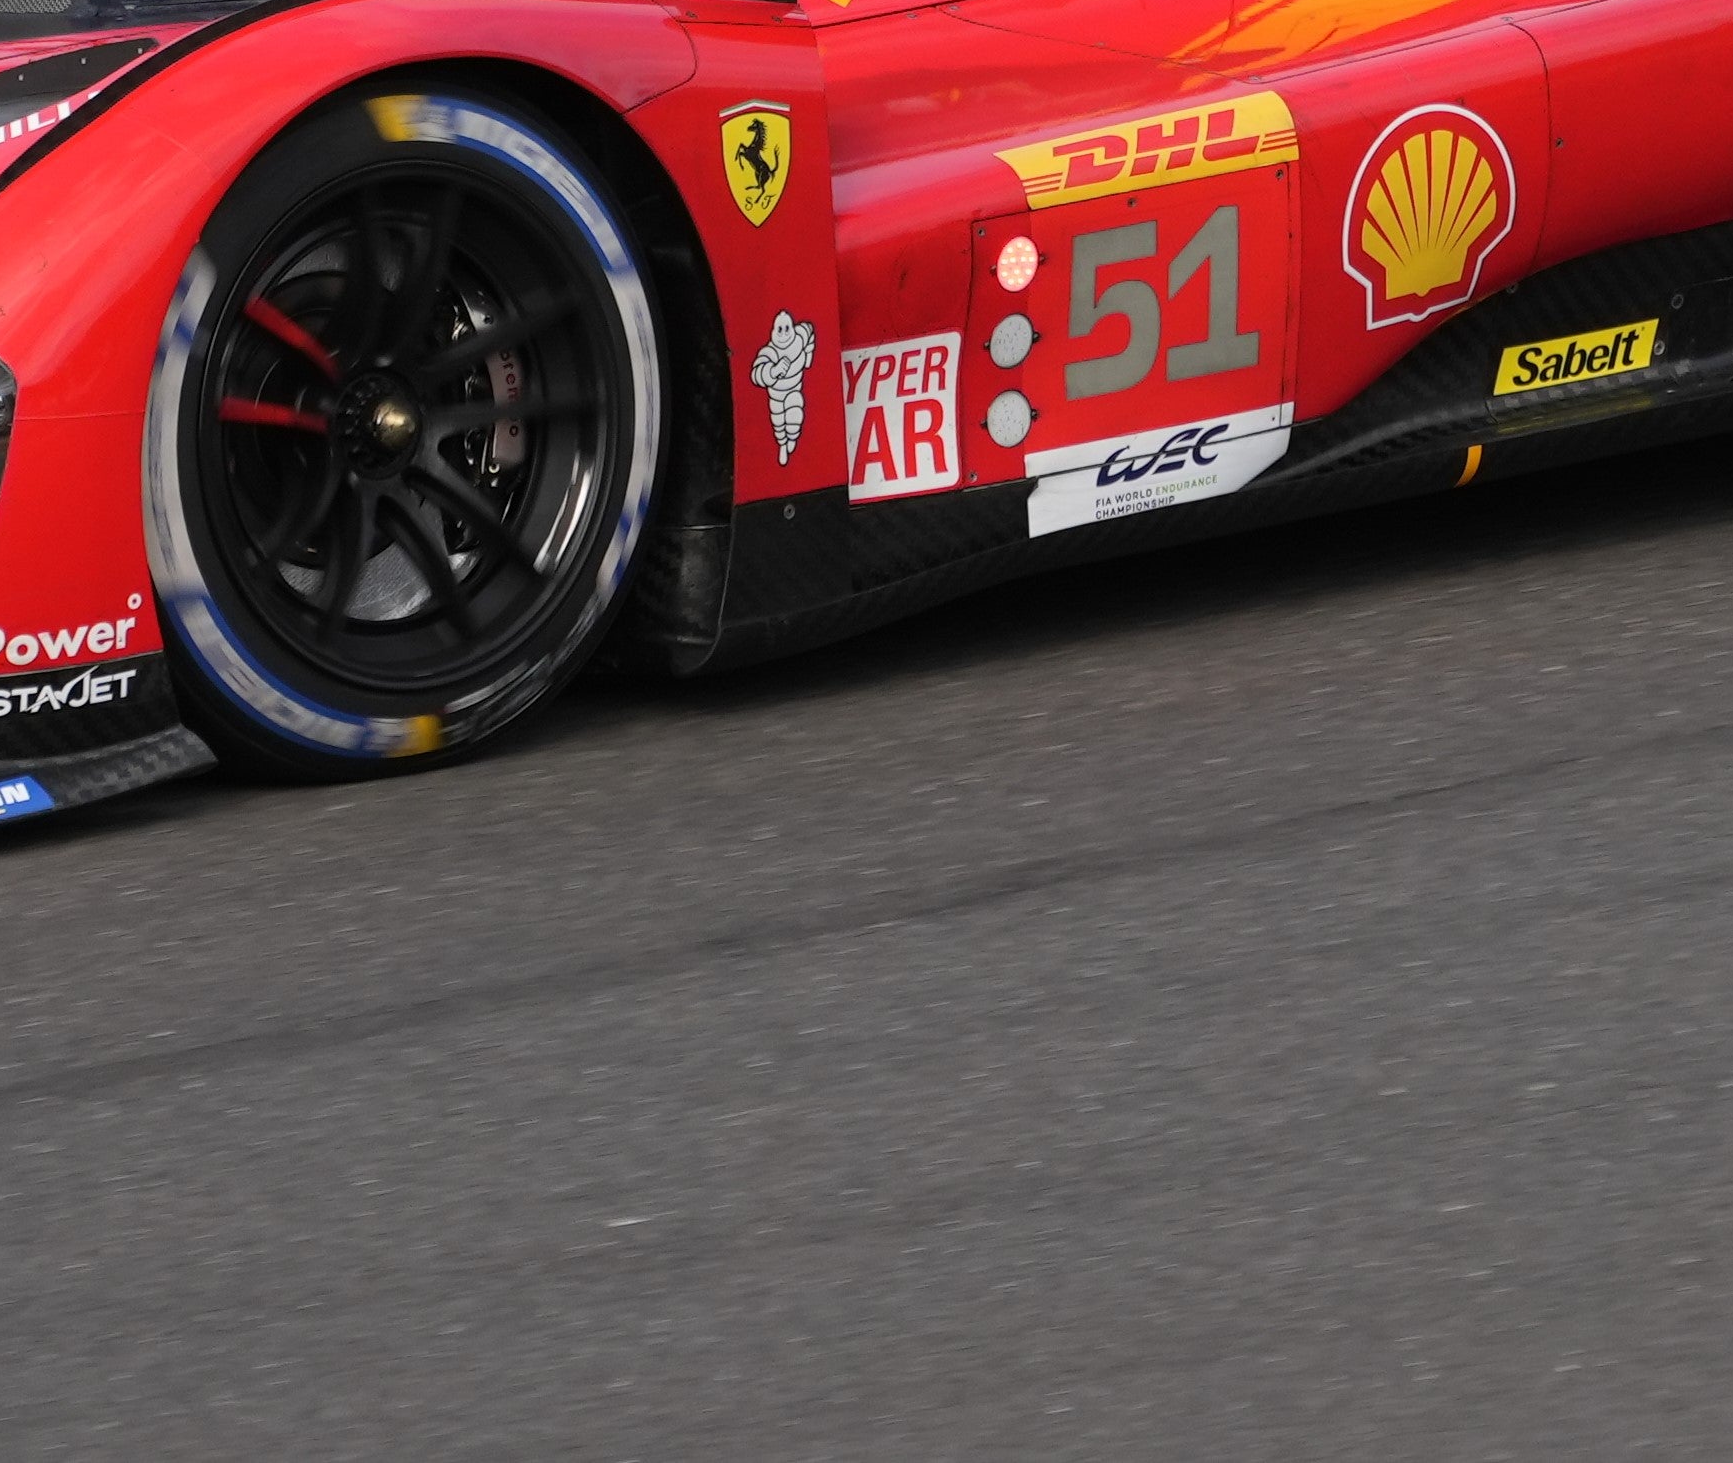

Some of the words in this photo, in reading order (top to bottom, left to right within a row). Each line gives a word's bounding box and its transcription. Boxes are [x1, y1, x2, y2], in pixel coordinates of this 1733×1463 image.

[1051, 108, 1261, 189] DHL
[1063, 205, 1261, 401] 51
[844, 345, 949, 405] YPER
[1511, 328, 1641, 387] Sabelt
[851, 399, 948, 486] AR
[1096, 423, 1229, 487] WEC
[1095, 497, 1112, 508] FIA
[1115, 488, 1152, 504] WORLD
[1155, 475, 1218, 496] ENDURANCE
[1095, 496, 1175, 520] CHAMPIONSHIP
